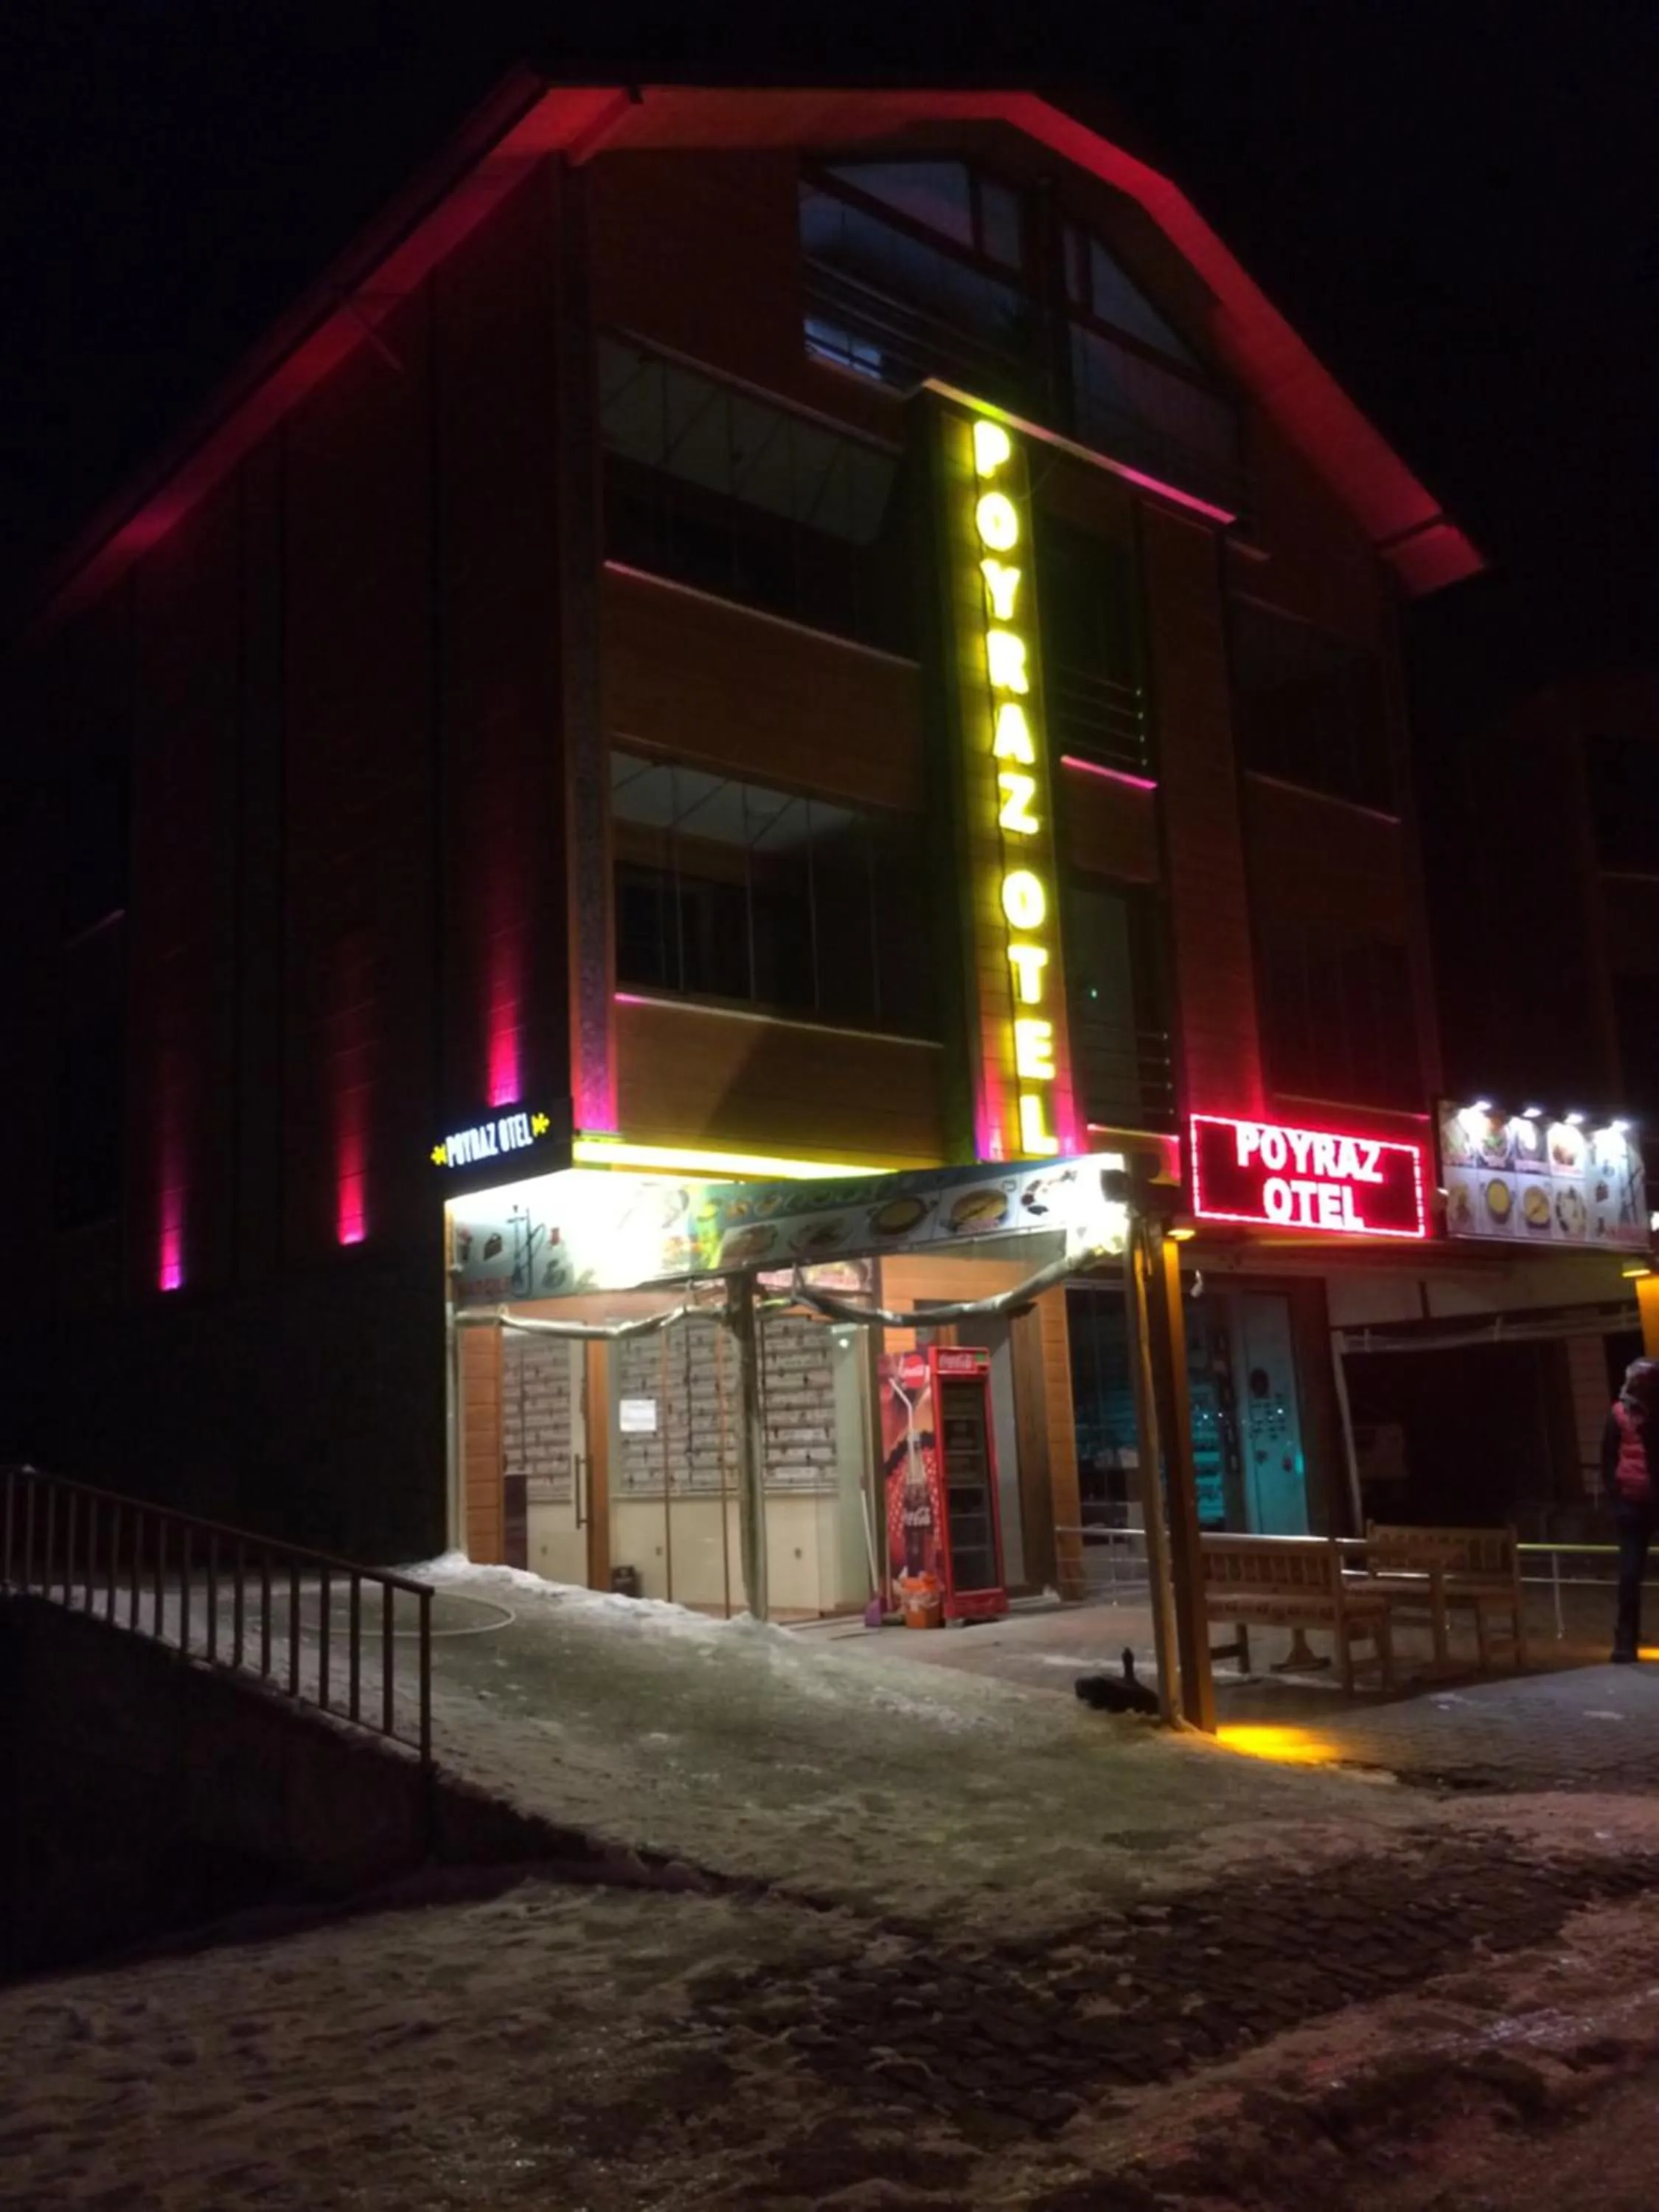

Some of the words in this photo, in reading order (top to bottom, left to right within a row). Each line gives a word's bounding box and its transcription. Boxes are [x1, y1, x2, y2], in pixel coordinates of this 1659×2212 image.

[973, 420, 1040, 835] POYRAZ
[1001, 870, 1059, 1156] OTEL
[498, 1113, 533, 1152] OTEL
[1236, 1123, 1382, 1183] POYRAZ
[1263, 1177, 1364, 1231] OTEL
